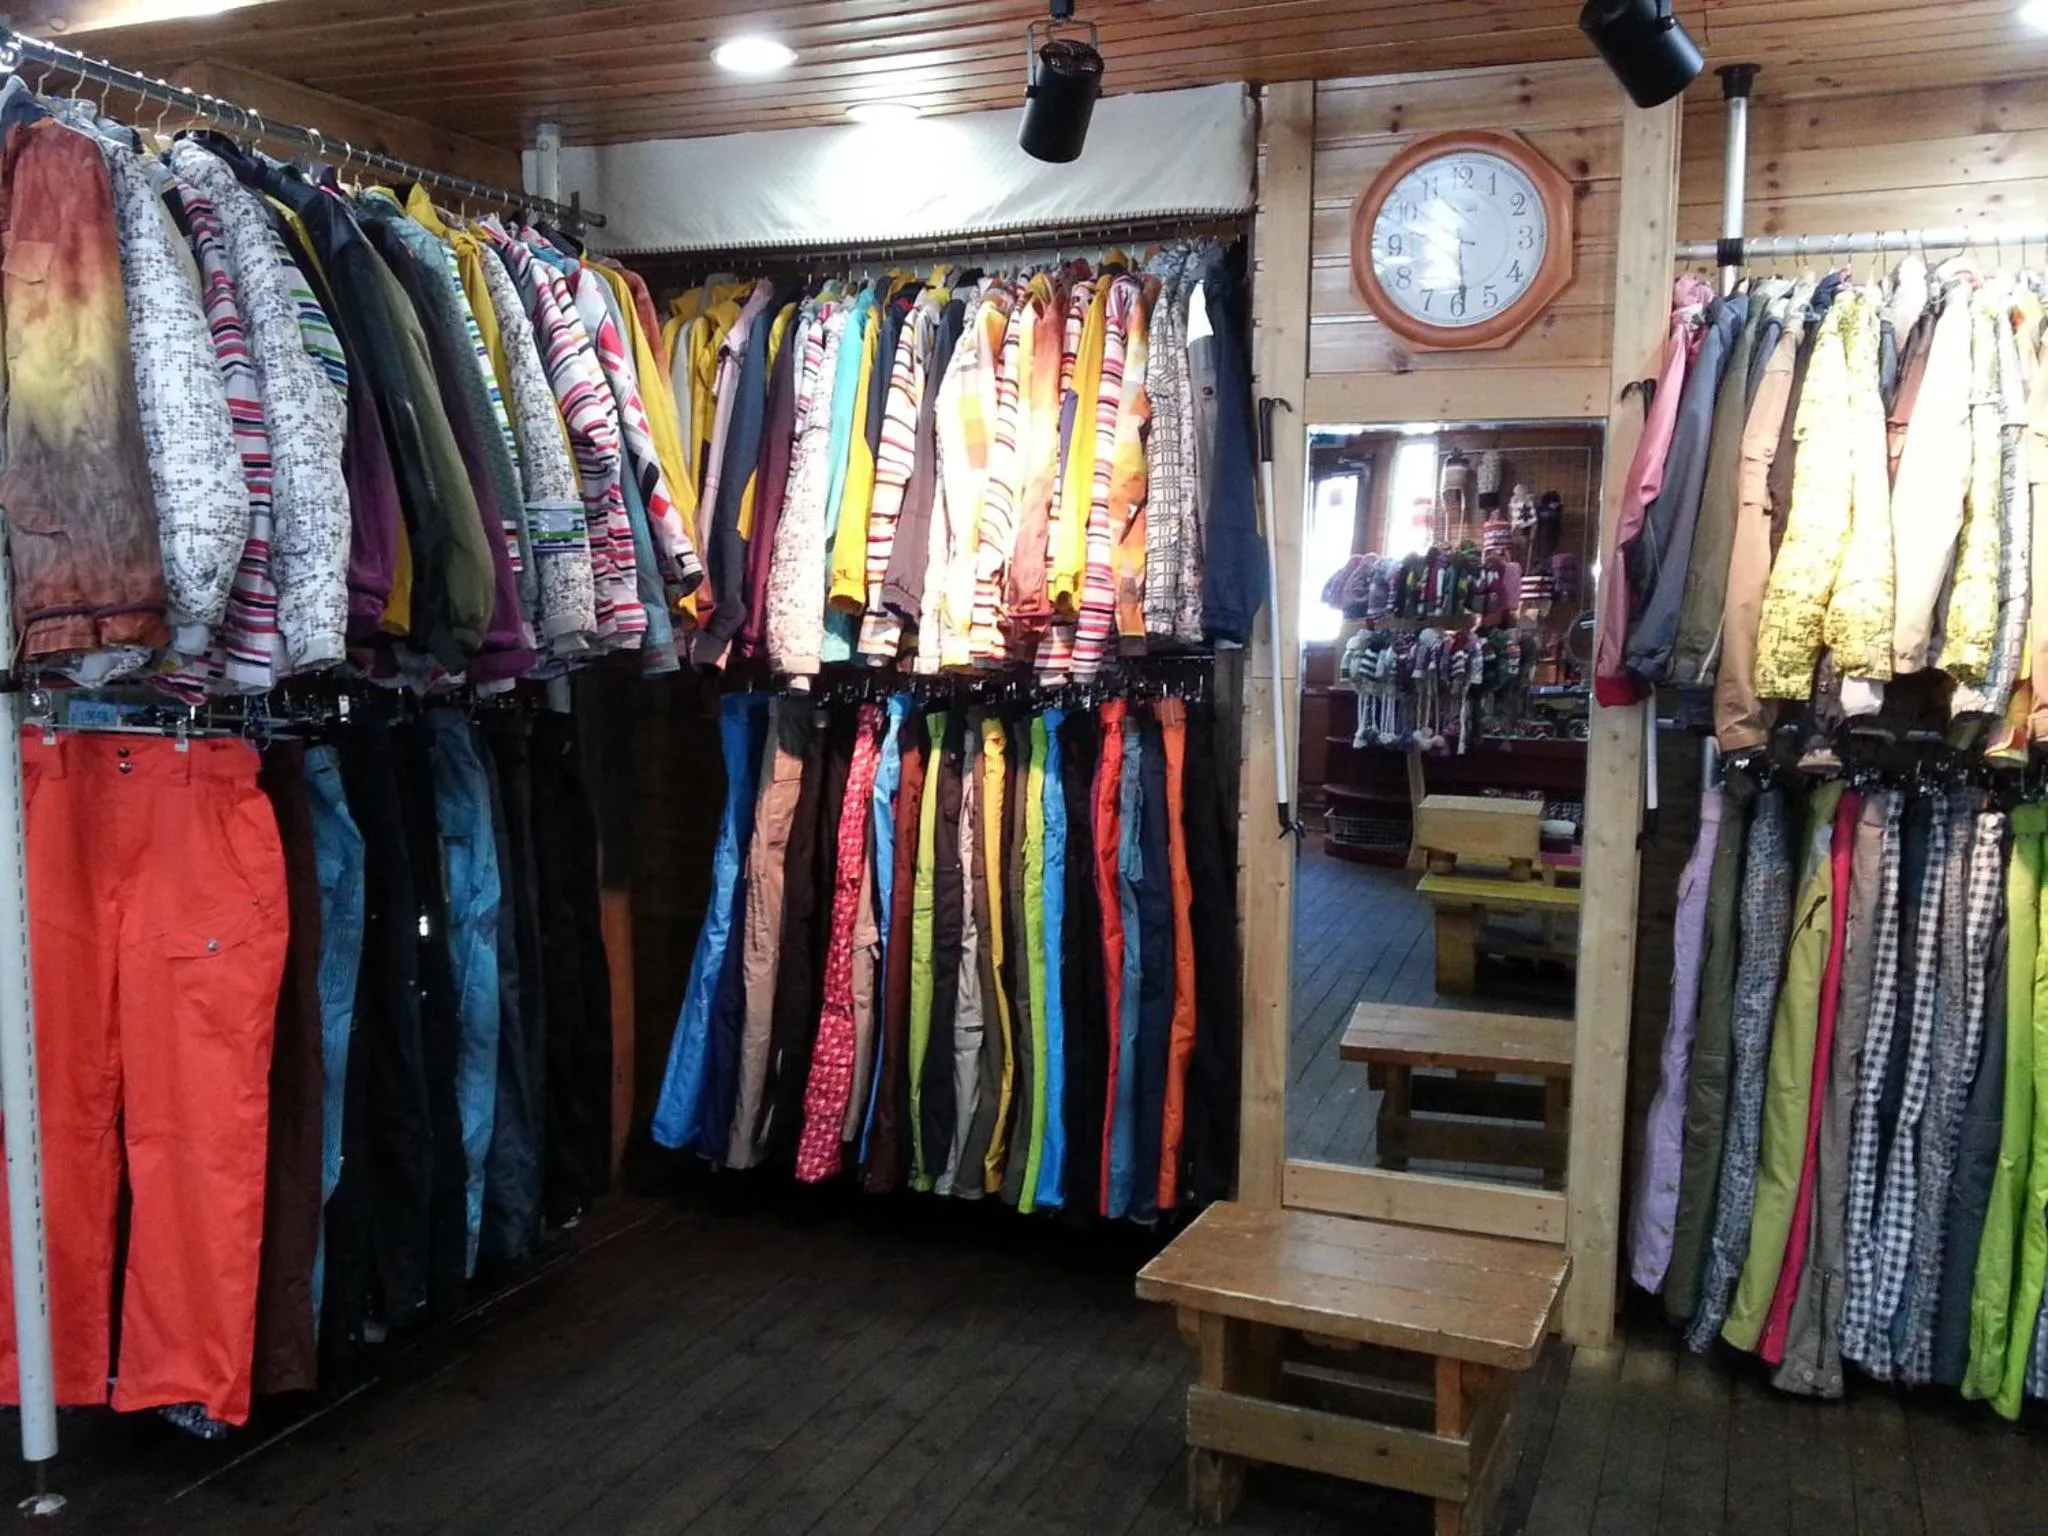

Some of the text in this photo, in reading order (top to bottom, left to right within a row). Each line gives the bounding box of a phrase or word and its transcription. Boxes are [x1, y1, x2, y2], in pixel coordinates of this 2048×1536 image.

[1453, 166, 1474, 190] 12
[1488, 172, 1497, 196] 1
[1511, 193, 1526, 216] 2
[1388, 233, 1402, 256] 9
[1518, 226, 1534, 249] 3
[1397, 266, 1412, 290] 8
[1506, 260, 1524, 283] 4
[1420, 288, 1435, 311] 7
[1450, 292, 1466, 317] 6
[1483, 285, 1498, 308] 5
